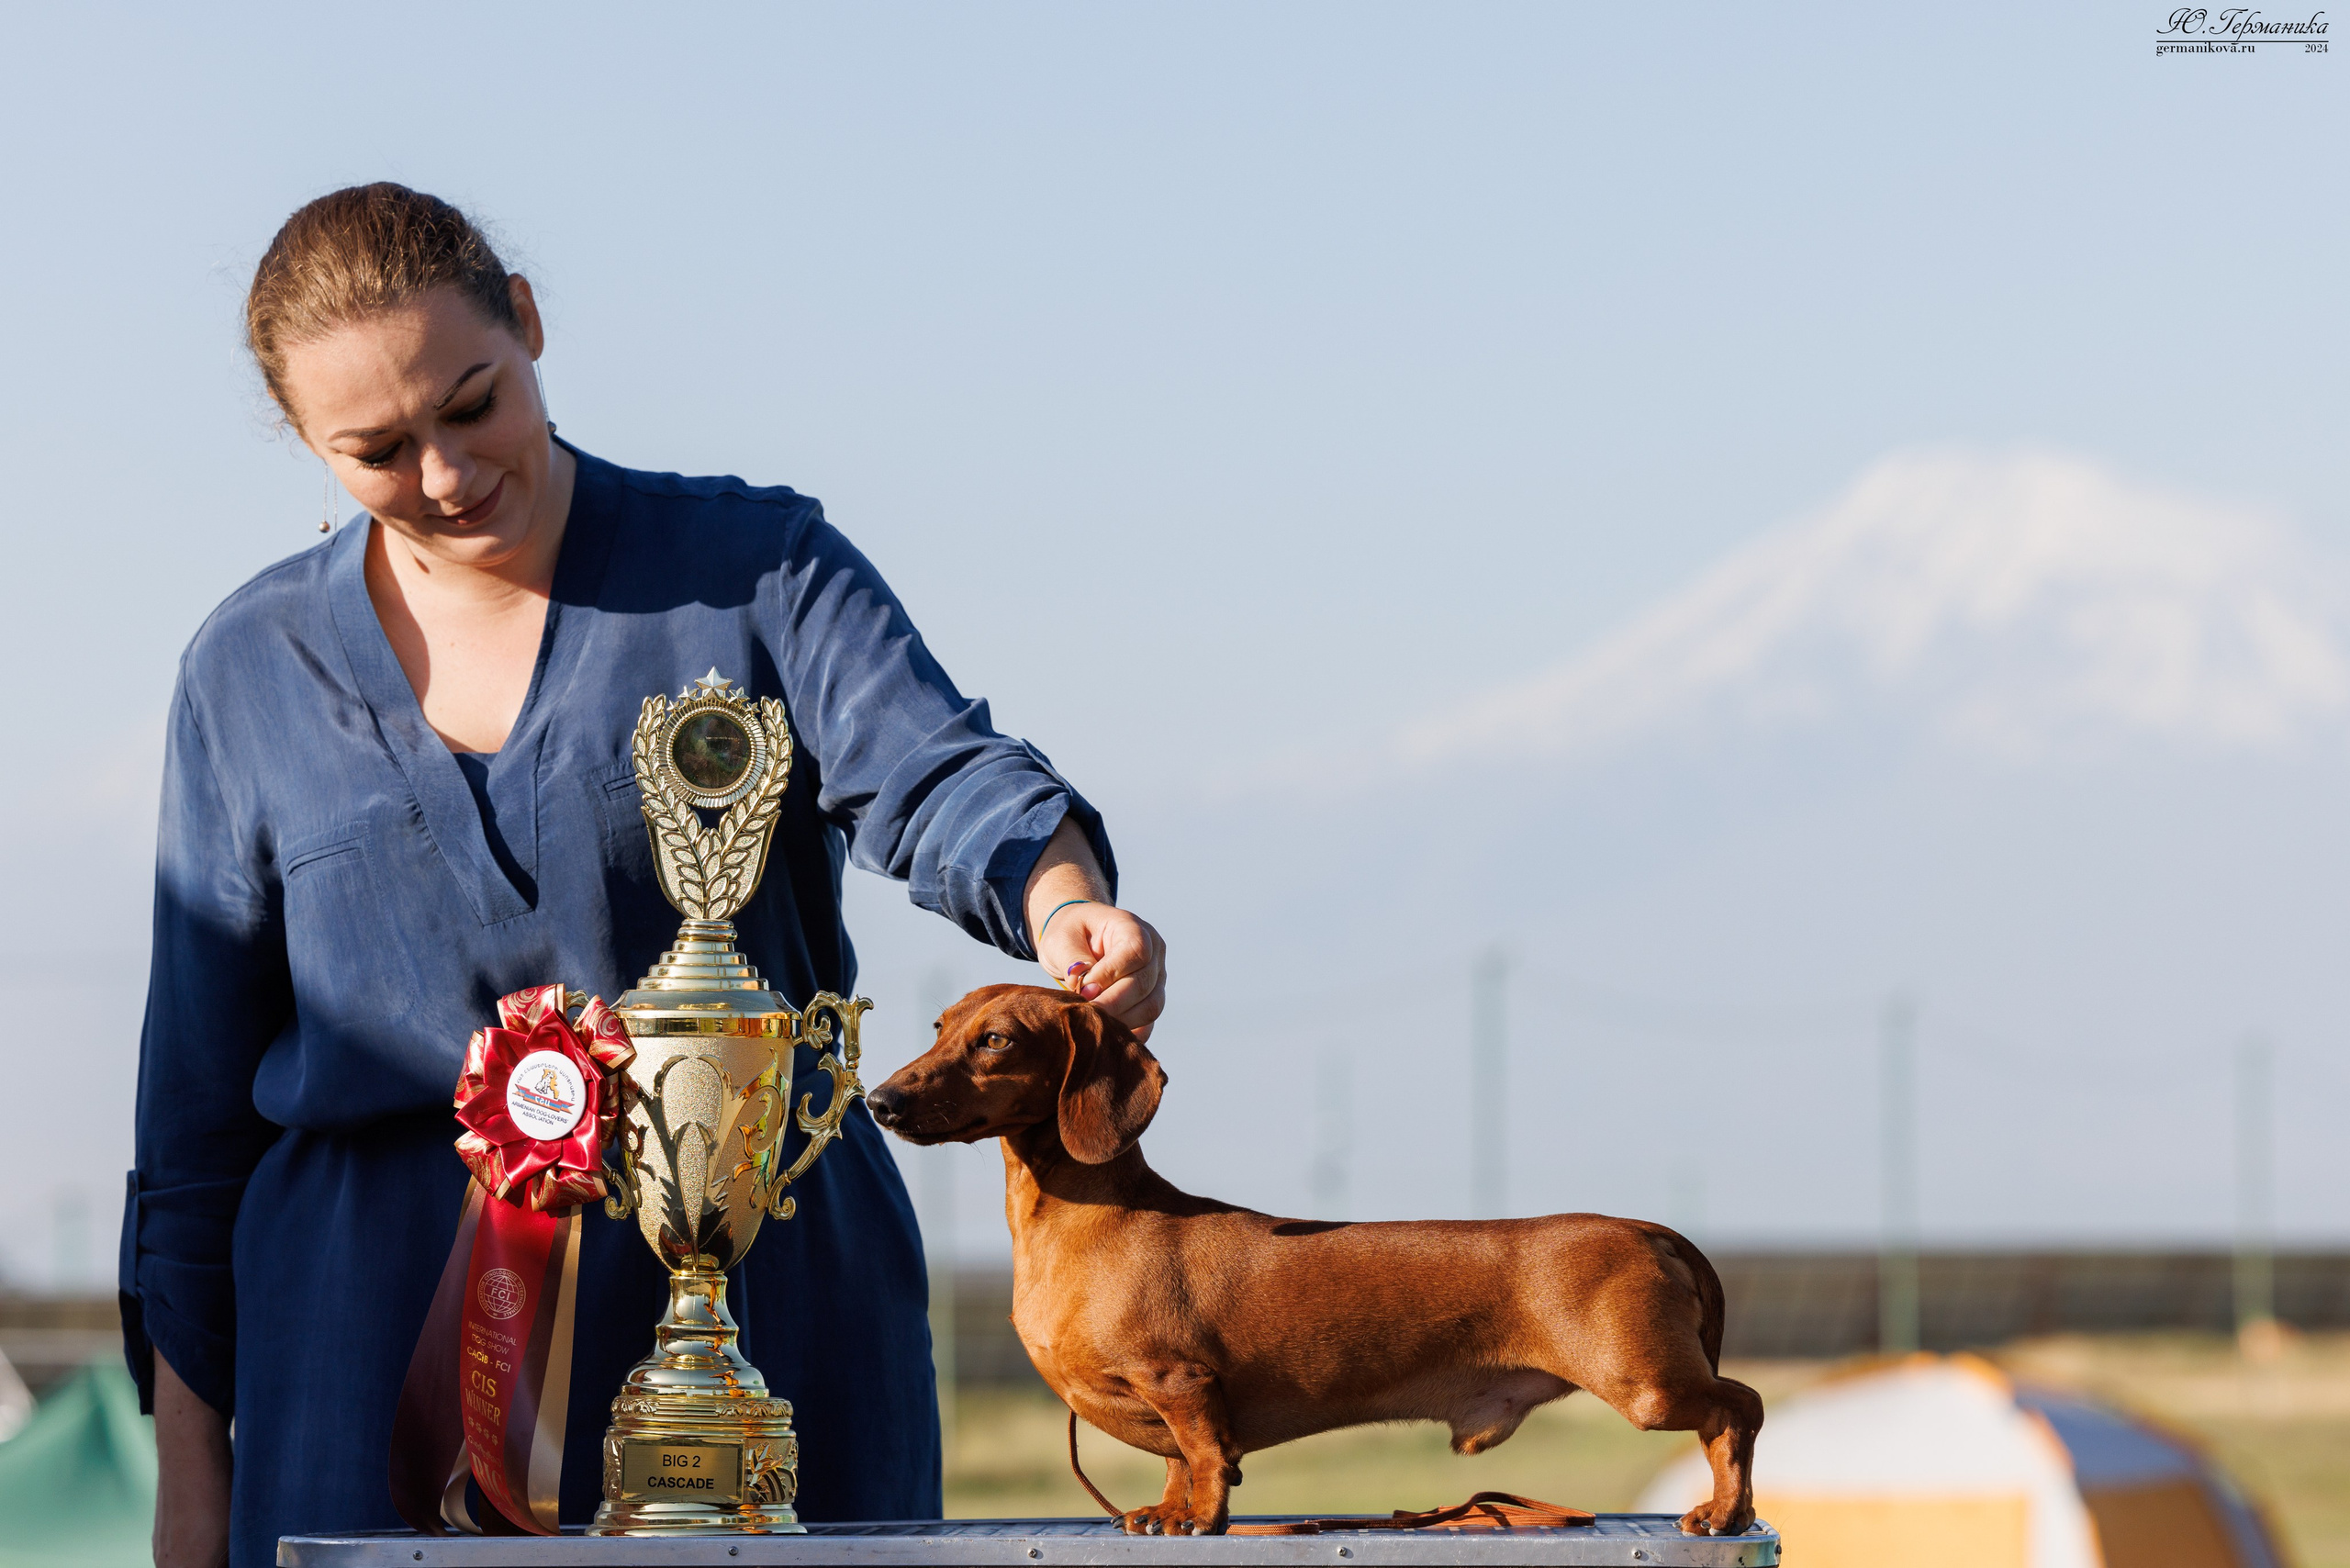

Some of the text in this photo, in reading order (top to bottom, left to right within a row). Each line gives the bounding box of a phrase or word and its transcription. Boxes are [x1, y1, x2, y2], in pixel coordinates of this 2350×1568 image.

[511, 1101, 535, 1114] ARMENIAN
[522, 1111, 554, 1126] ASSOCIATION
[491, 1287, 510, 1301] FCI
[468, 1321, 517, 1346] INTERNATIONAL
[471, 1333, 509, 1355] DOG SHOW
[466, 1346, 488, 1364] CACIB
[496, 1360, 511, 1373] FCI
[471, 1370, 497, 1398] CIS
[464, 1387, 500, 1427] WINNER
[663, 1454, 701, 1468] BIG 2
[647, 1476, 714, 1489] CASCADE
